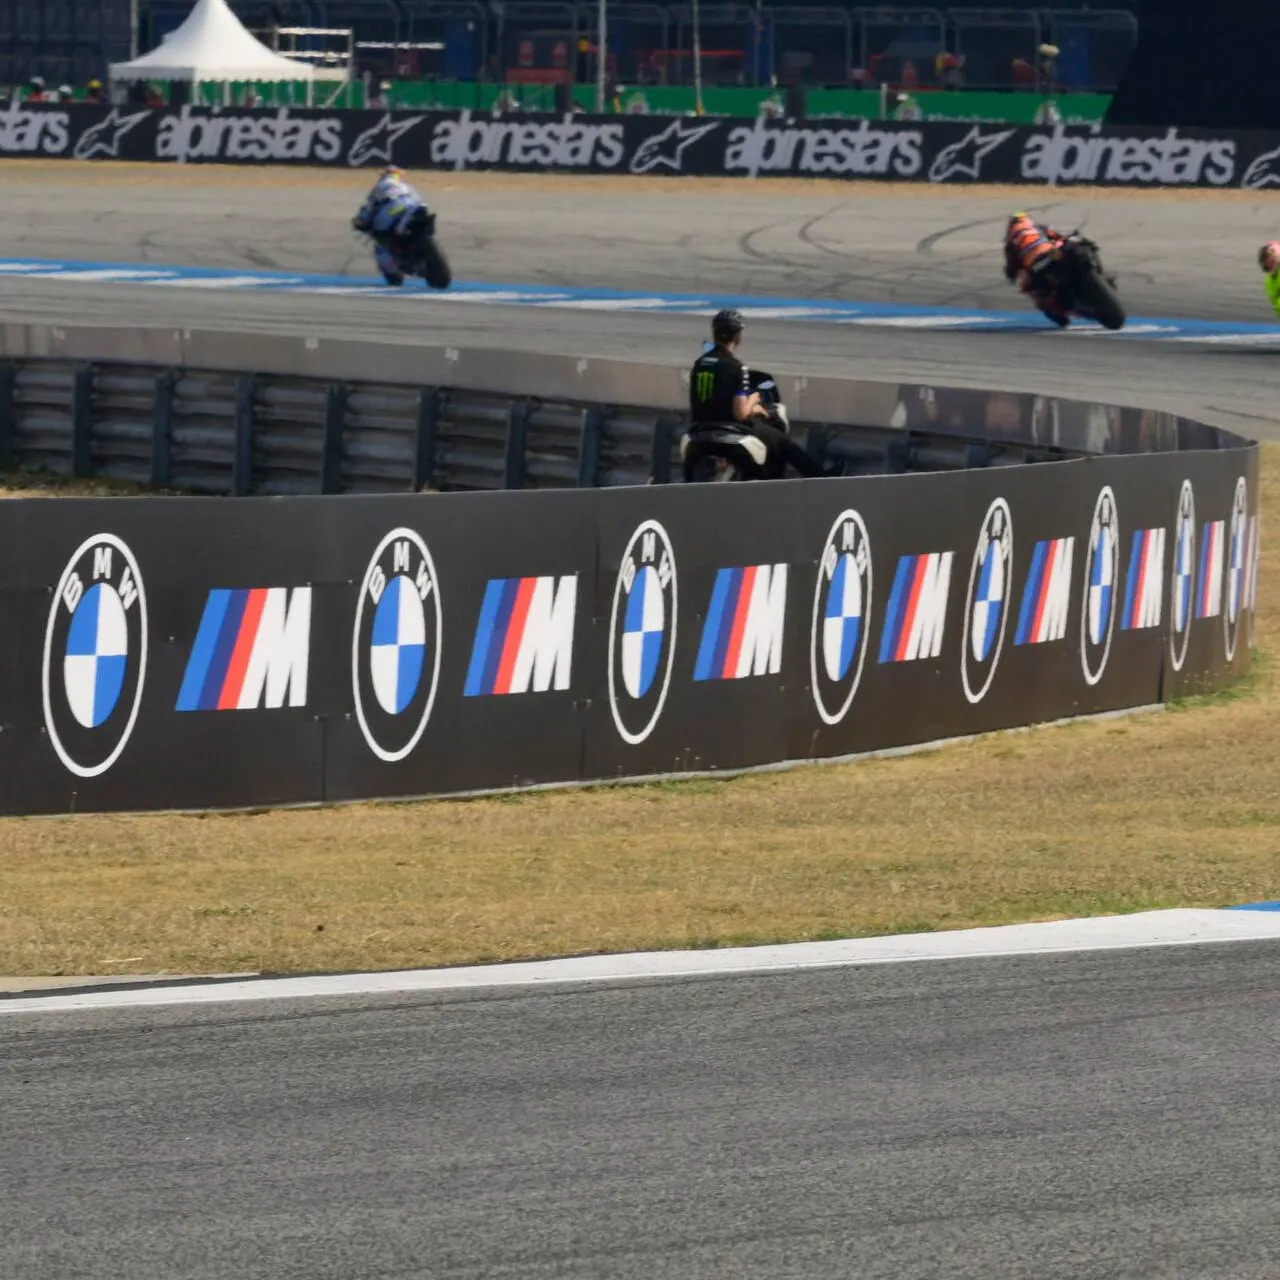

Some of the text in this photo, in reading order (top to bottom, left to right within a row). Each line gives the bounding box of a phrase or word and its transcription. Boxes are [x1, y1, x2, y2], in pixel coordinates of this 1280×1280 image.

[155, 104, 342, 164] alpinestars
[431, 109, 623, 170] alpinestars
[725, 115, 923, 180] alpinestars
[1021, 122, 1236, 187] alpinestars
[62, 547, 138, 613] BMW
[368, 542, 433, 606] BMW
[622, 531, 672, 595] BMW
